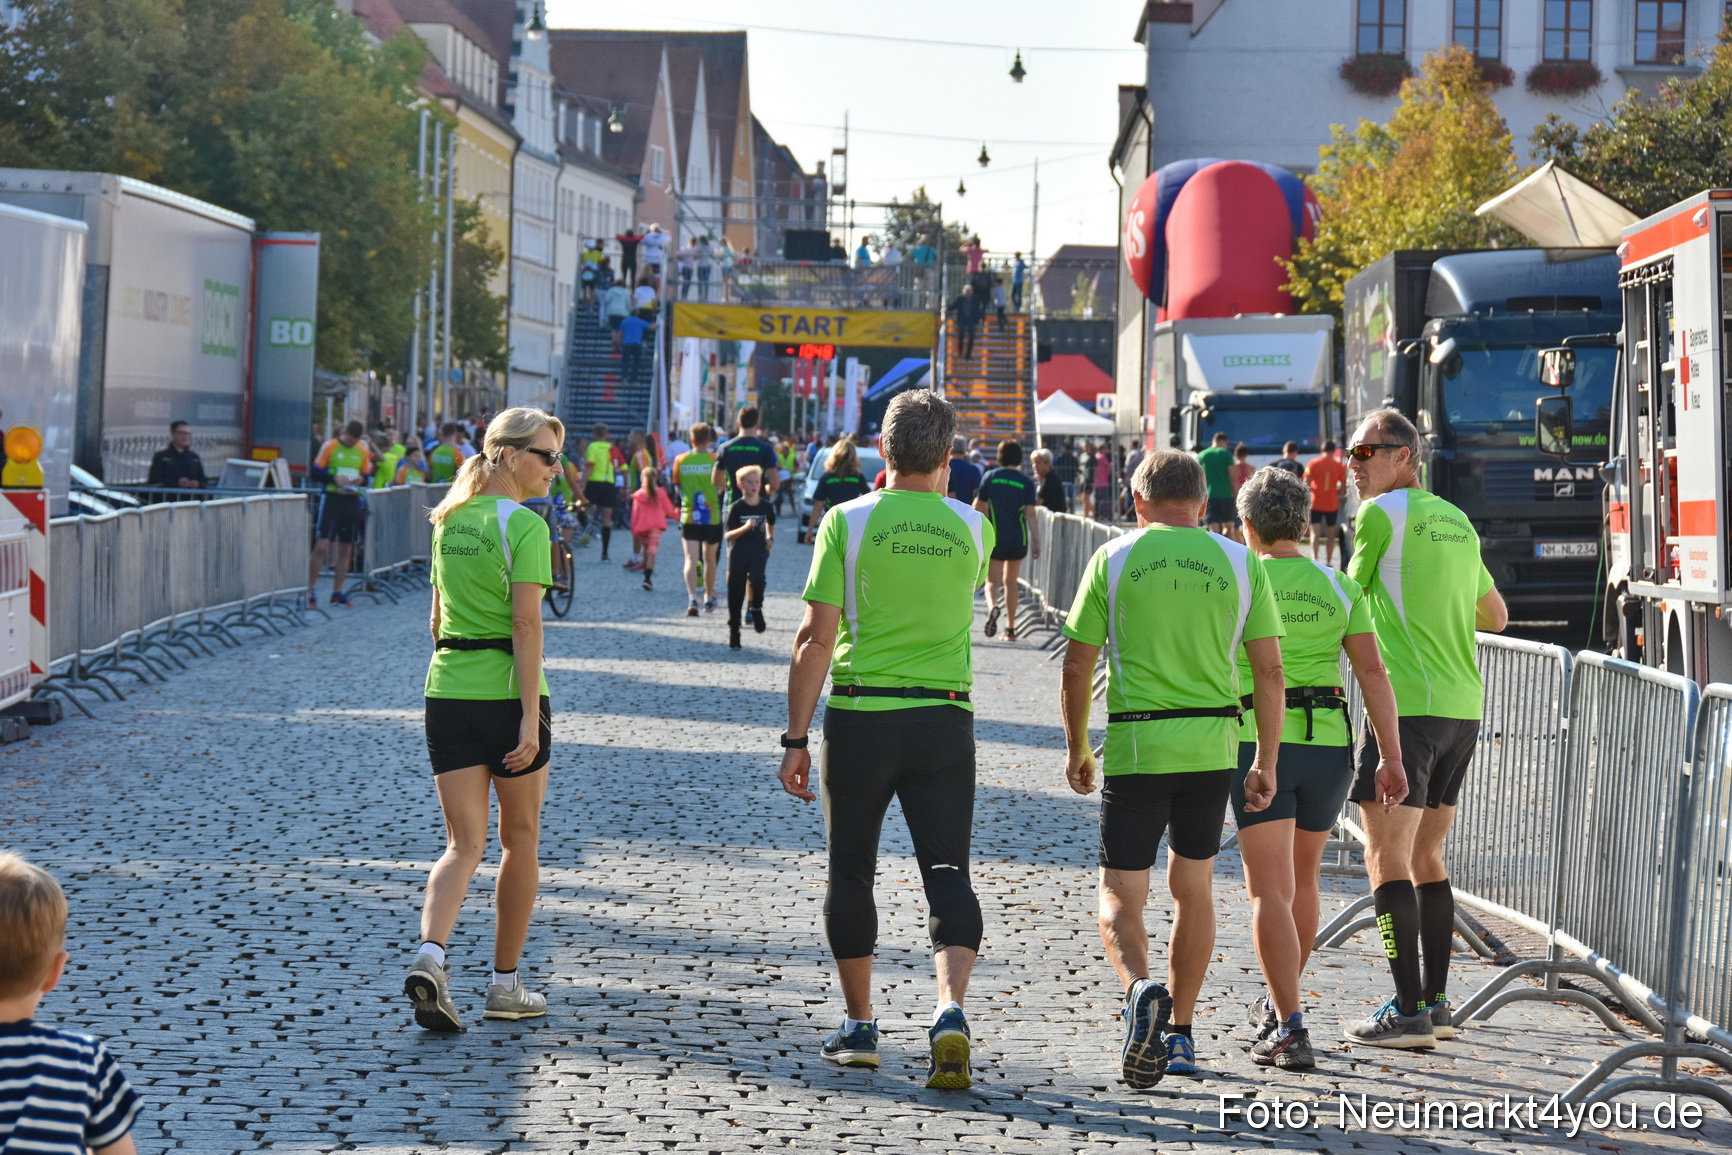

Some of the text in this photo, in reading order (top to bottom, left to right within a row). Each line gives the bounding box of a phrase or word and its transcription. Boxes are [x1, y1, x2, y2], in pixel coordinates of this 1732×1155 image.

[759, 313, 849, 337] START
[1223, 354, 1292, 368] BOCK
[1534, 467, 1595, 481] MAN
[872, 521, 970, 555] Ski- und Laufabteilung
[441, 543, 480, 556] Ezelsdorf
[892, 541, 953, 557] Ezelsdorf
[1542, 544, 1596, 555] NM NL 234
[1149, 557, 1167, 571] und
[1280, 589, 1336, 617] Laufabteilung
[1281, 610, 1320, 624] elsdorf
